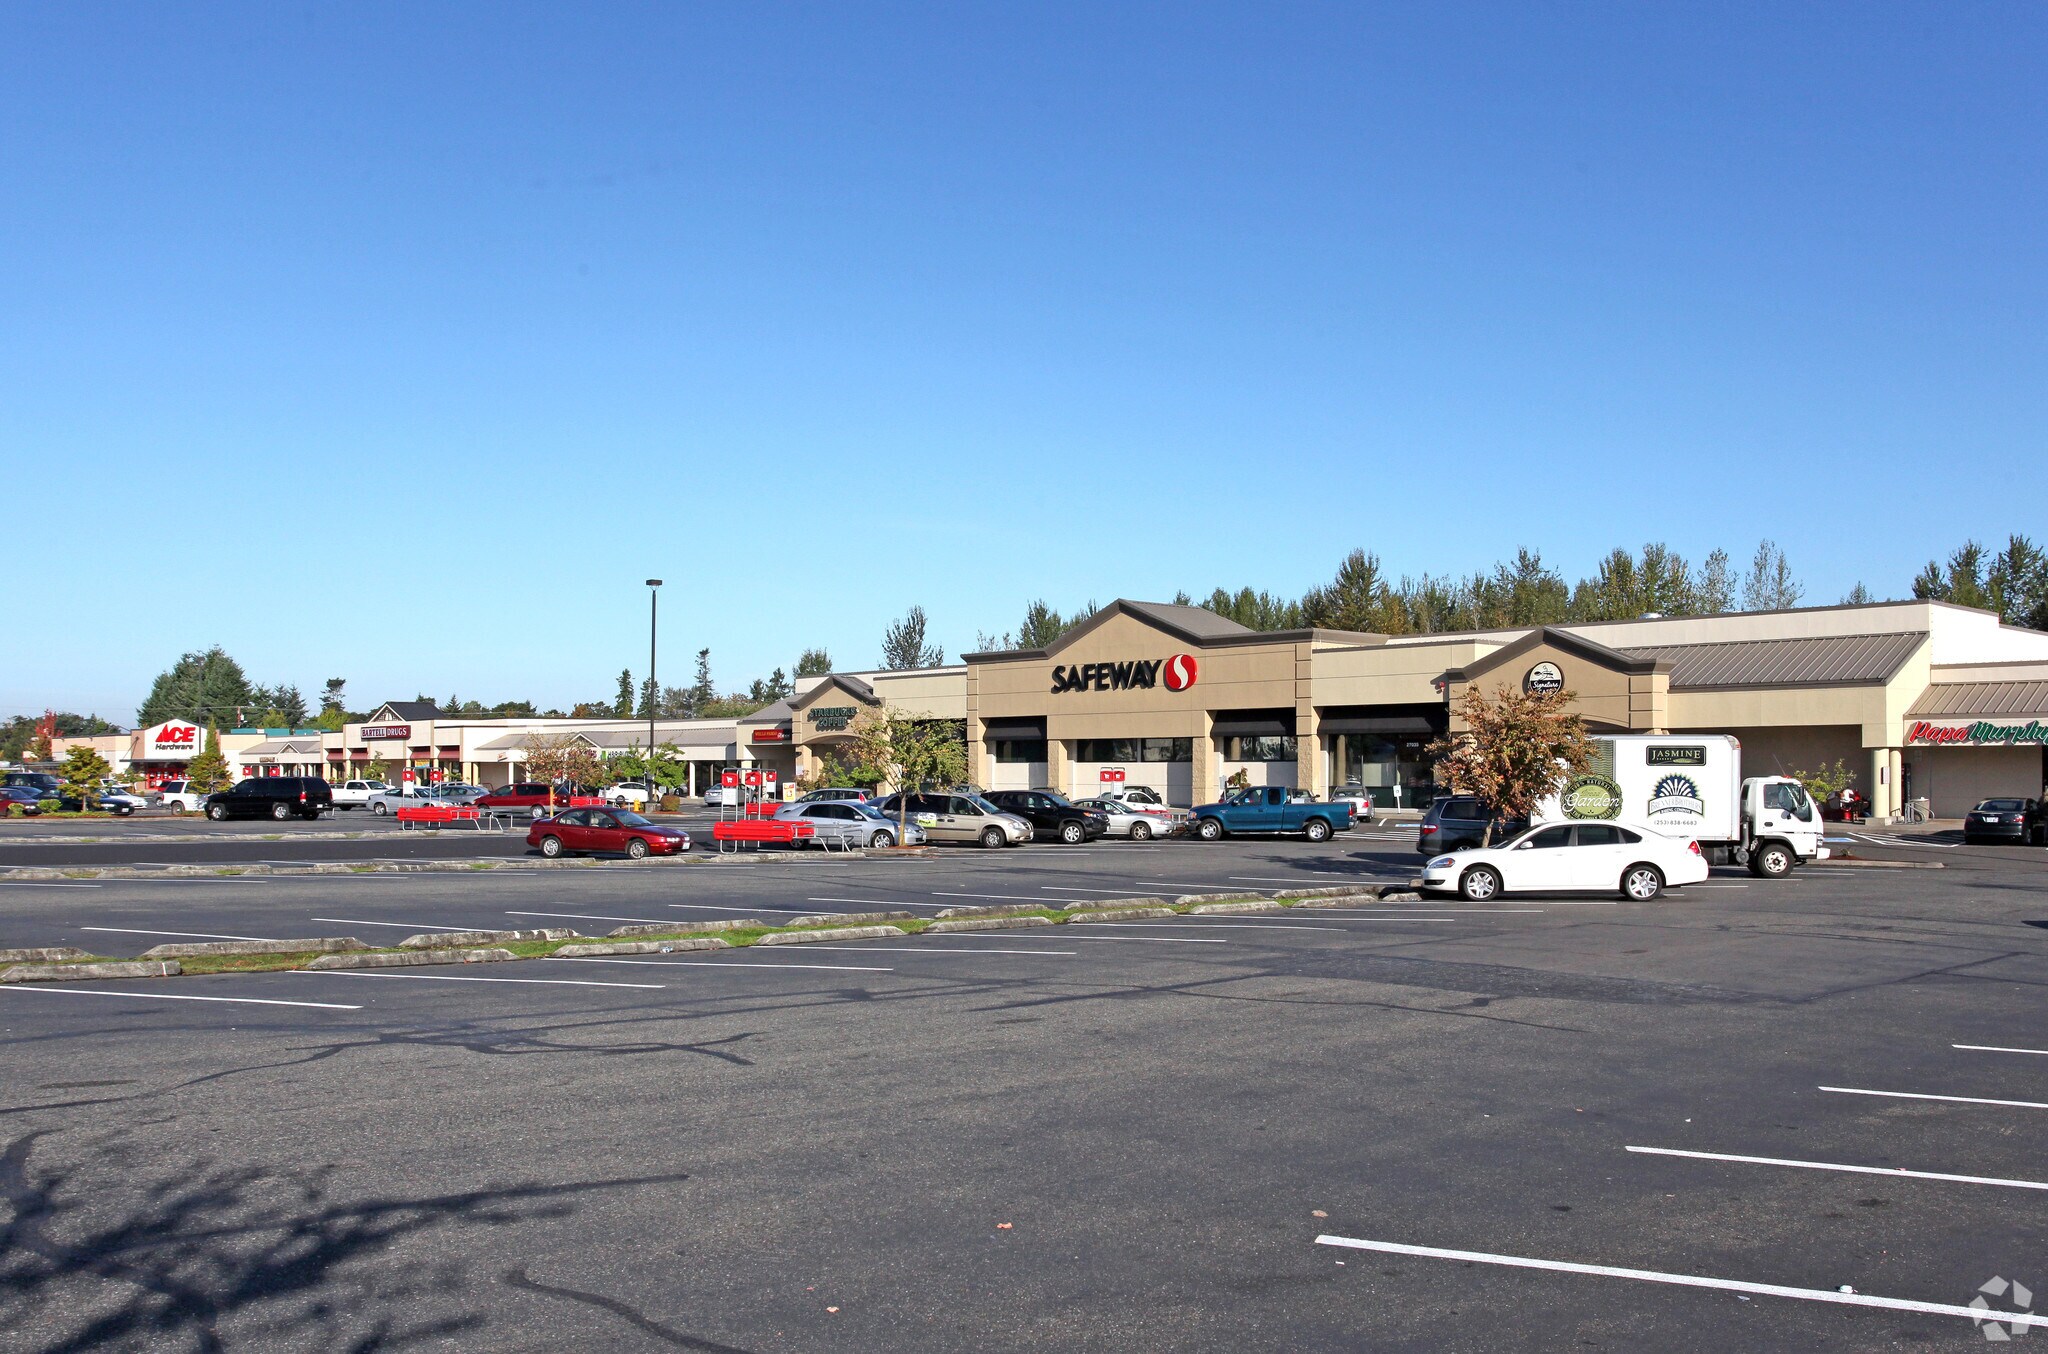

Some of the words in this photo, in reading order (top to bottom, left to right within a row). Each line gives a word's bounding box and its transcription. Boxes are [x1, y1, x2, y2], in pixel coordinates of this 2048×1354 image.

[1051, 659, 1163, 694] SAFEWAY
[808, 706, 857, 718] STARBUCKS
[817, 717, 848, 727] COFFEE
[155, 723, 196, 743] ACE
[362, 728, 385, 737] BARTELL
[386, 727, 407, 736] DRUGS
[1908, 720, 1970, 745] Papa
[1652, 750, 1701, 760] JASMINE
[1586, 779, 1611, 791] NATURAL
[1562, 792, 1619, 812] Garden
